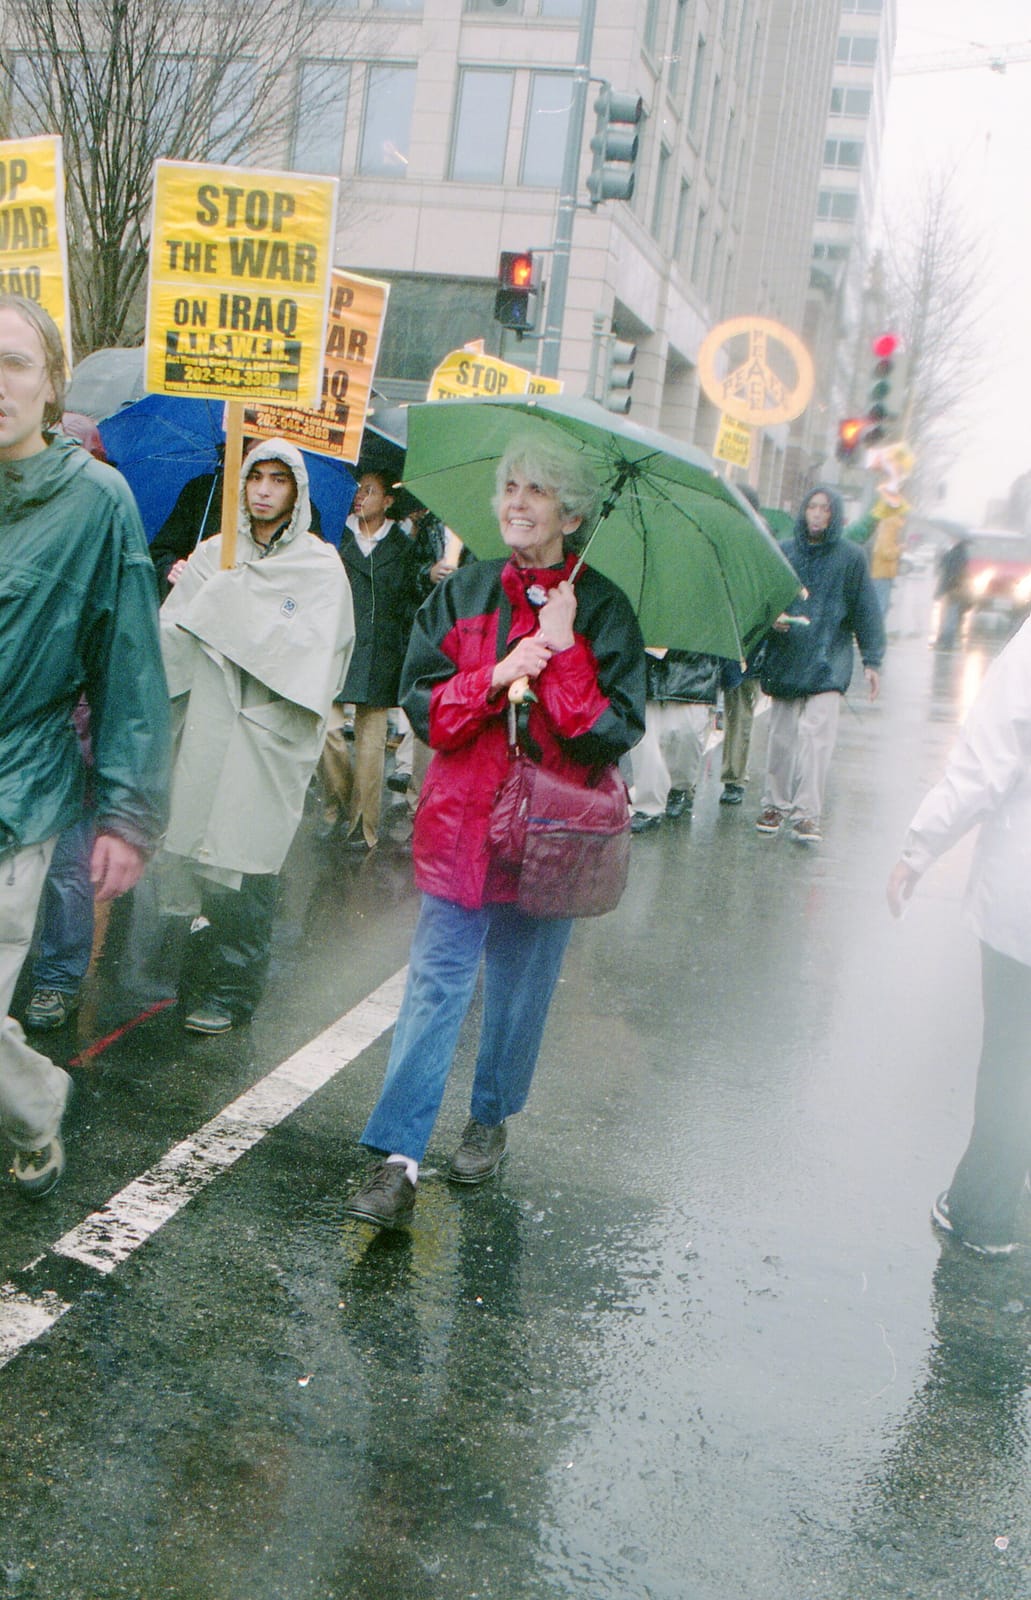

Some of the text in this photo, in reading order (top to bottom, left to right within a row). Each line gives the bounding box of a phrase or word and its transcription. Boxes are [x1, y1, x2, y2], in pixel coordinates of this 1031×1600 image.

[0, 158, 28, 200] P
[196, 184, 296, 233] STOP
[166, 237, 318, 284] THE WAR
[174, 293, 298, 338] ON IRAQ
[329, 286, 354, 320] P
[326, 324, 368, 363] AR
[184, 365, 280, 388] 202-544-3389
[456, 361, 508, 395] STOP
